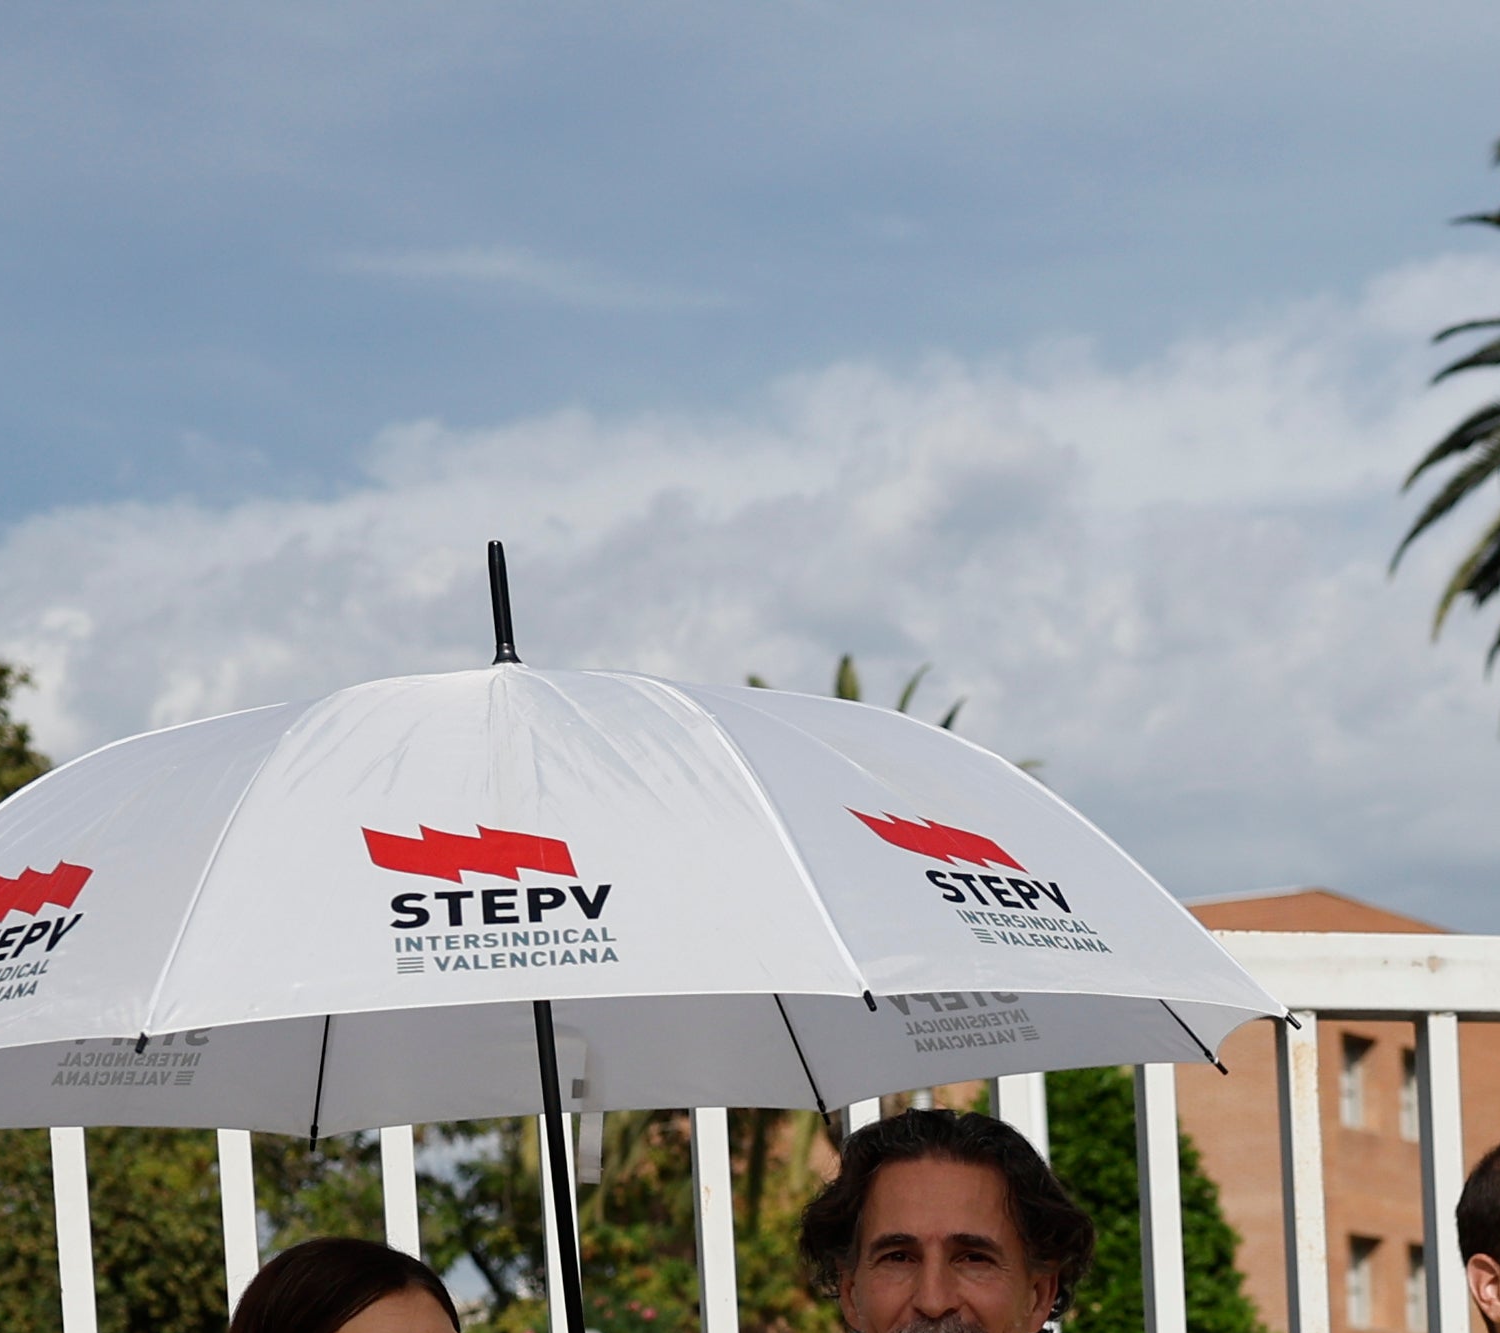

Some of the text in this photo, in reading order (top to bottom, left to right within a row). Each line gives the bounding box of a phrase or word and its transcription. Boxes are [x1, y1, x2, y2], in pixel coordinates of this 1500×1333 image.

[925, 868, 1072, 914] STEPV
[390, 884, 612, 929] STEPV
[956, 908, 1099, 936] INTERSINDICAL
[395, 927, 617, 953] INTERSINDICAL
[993, 928, 1113, 955] VALENCIANA
[434, 947, 619, 972] VALENCIANA
